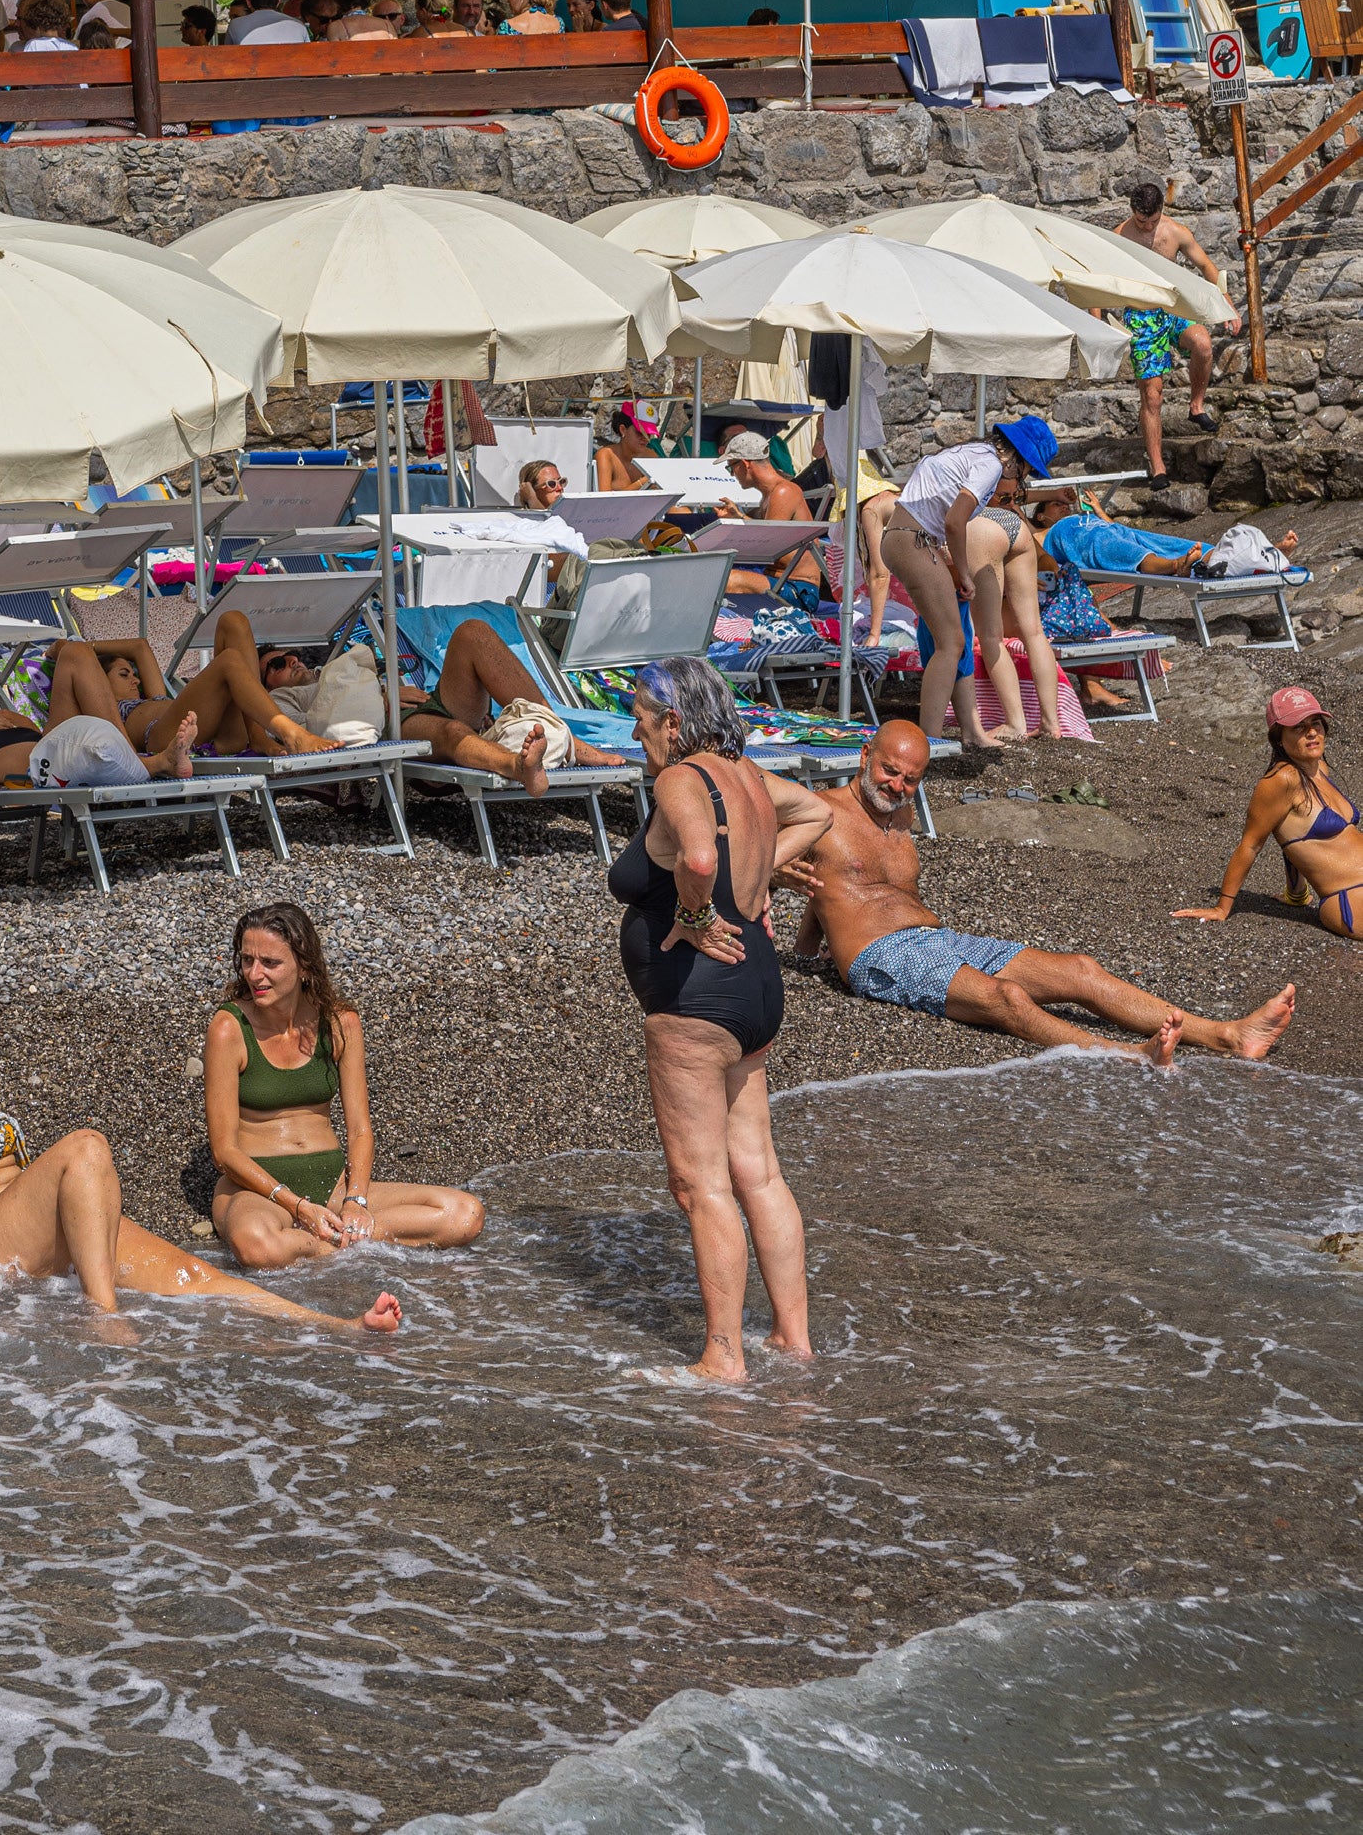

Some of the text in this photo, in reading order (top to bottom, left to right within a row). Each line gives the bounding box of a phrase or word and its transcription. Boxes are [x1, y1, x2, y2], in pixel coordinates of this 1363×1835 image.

[1212, 78, 1245, 92] VIETATO LO
[1213, 89, 1246, 102] SHAMPOO
